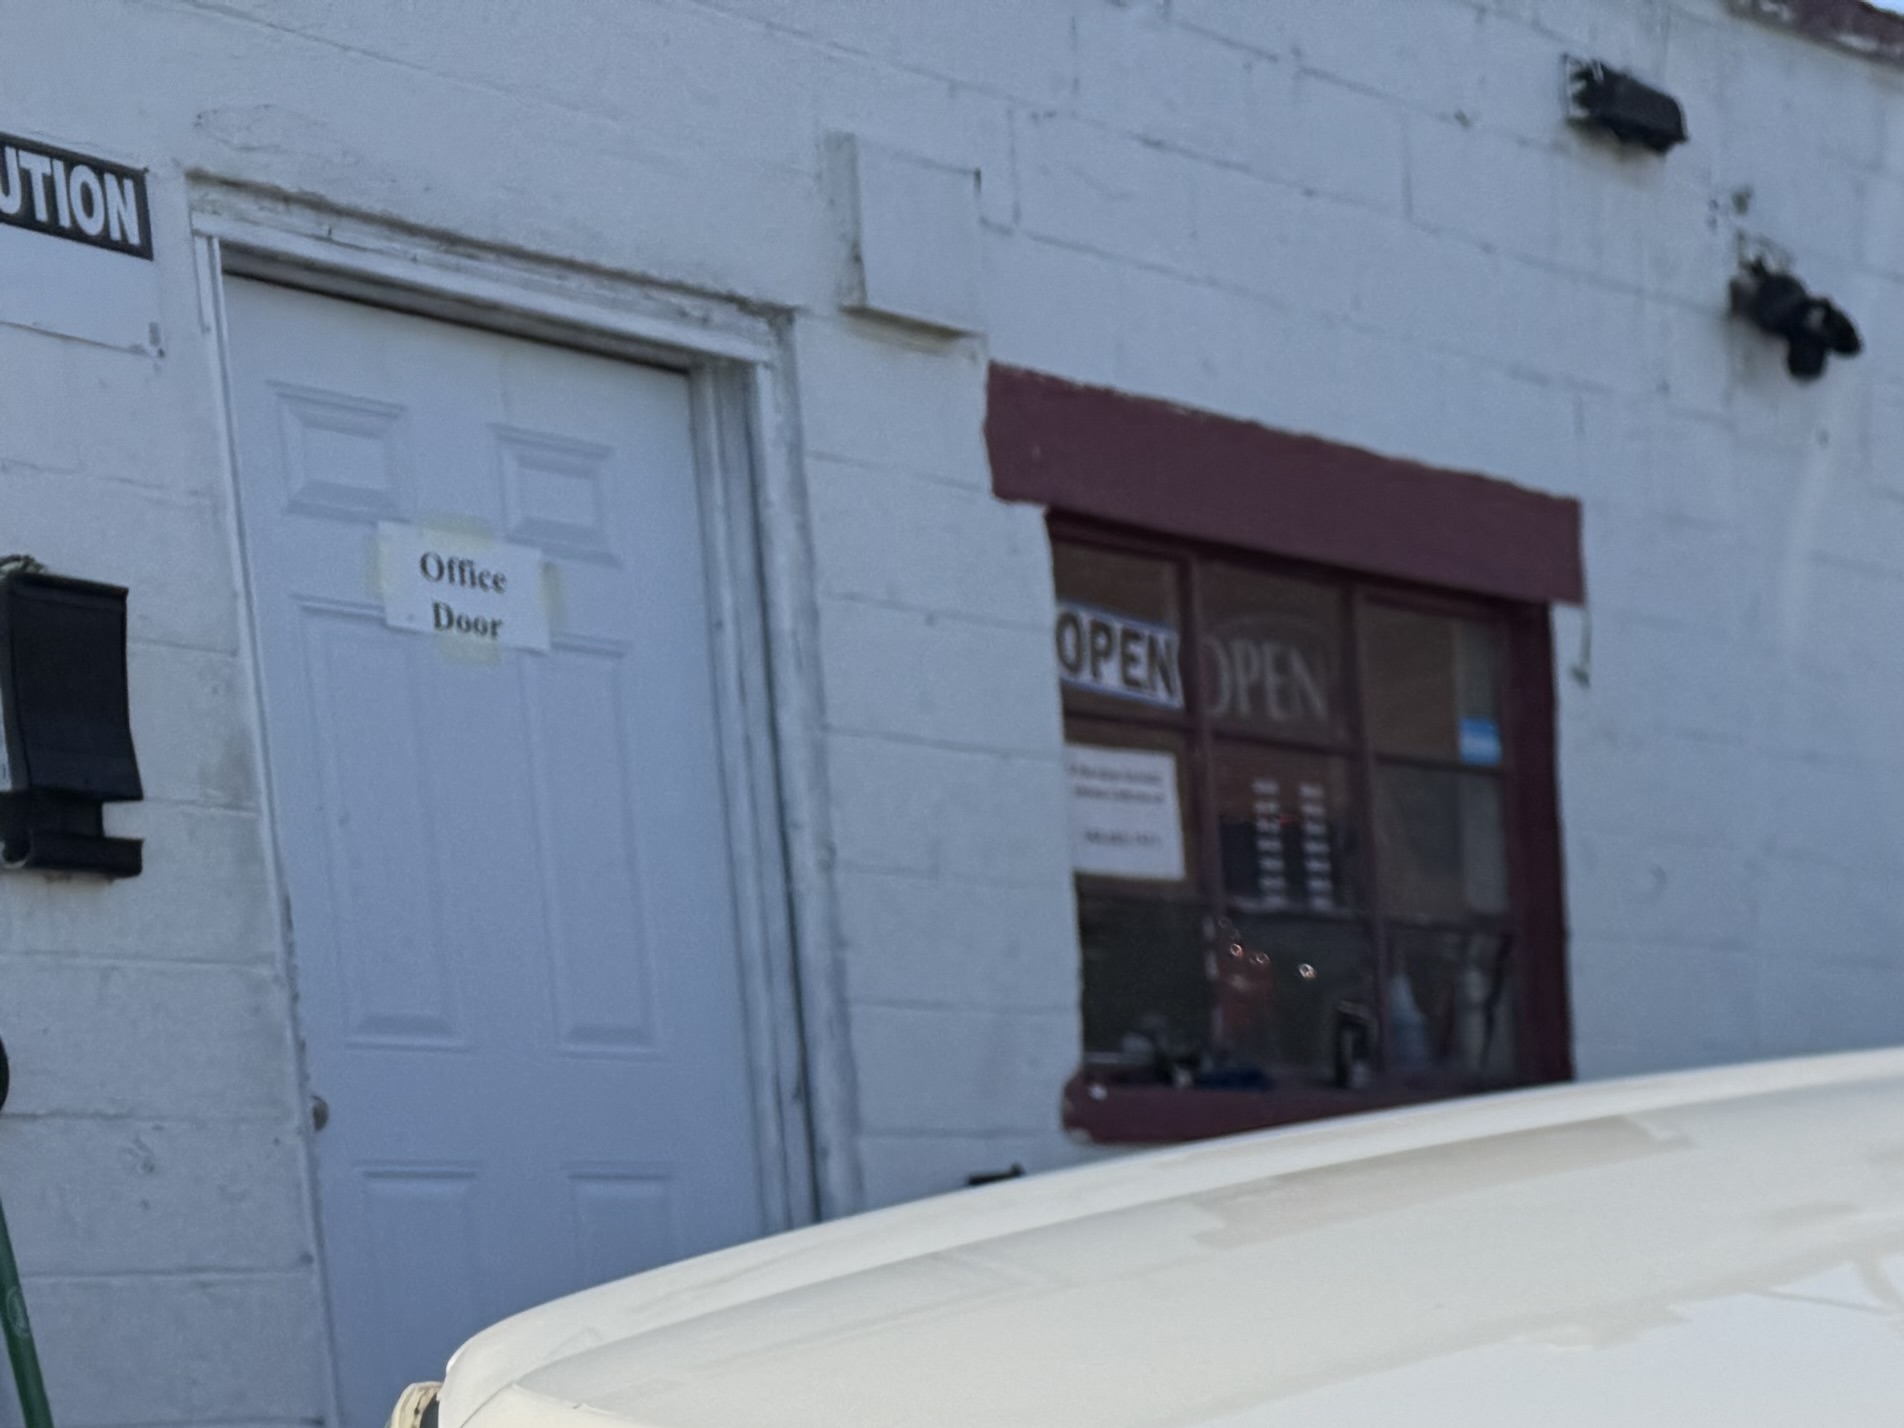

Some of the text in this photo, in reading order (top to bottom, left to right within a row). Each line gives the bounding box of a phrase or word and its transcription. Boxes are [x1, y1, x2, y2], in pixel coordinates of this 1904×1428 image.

[418, 551, 507, 595] Office
[432, 601, 503, 638] Door
[1055, 610, 1176, 700] OPEN
[1199, 634, 1329, 722] OPEN
